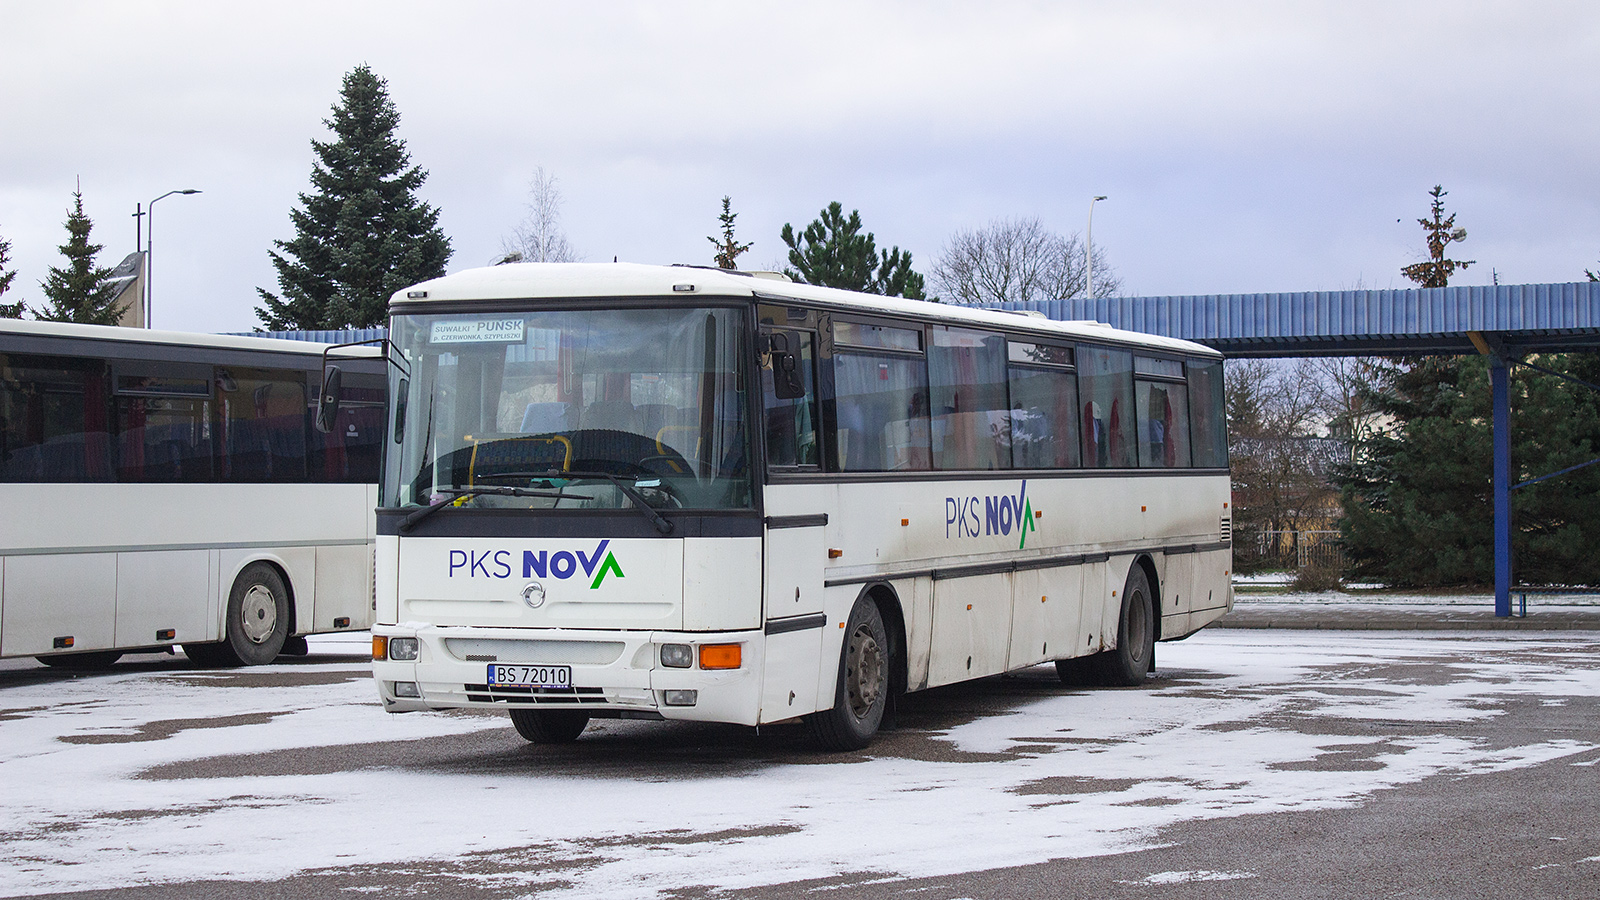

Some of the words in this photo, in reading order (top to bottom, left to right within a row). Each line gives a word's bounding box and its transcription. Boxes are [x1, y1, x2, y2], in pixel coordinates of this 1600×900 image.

[945, 496, 980, 538] PKS
[985, 480, 1035, 549] NOVA
[449, 550, 511, 578] PKS
[522, 539, 625, 589] NOVA
[498, 667, 516, 683] BS
[521, 668, 566, 684] 72010
